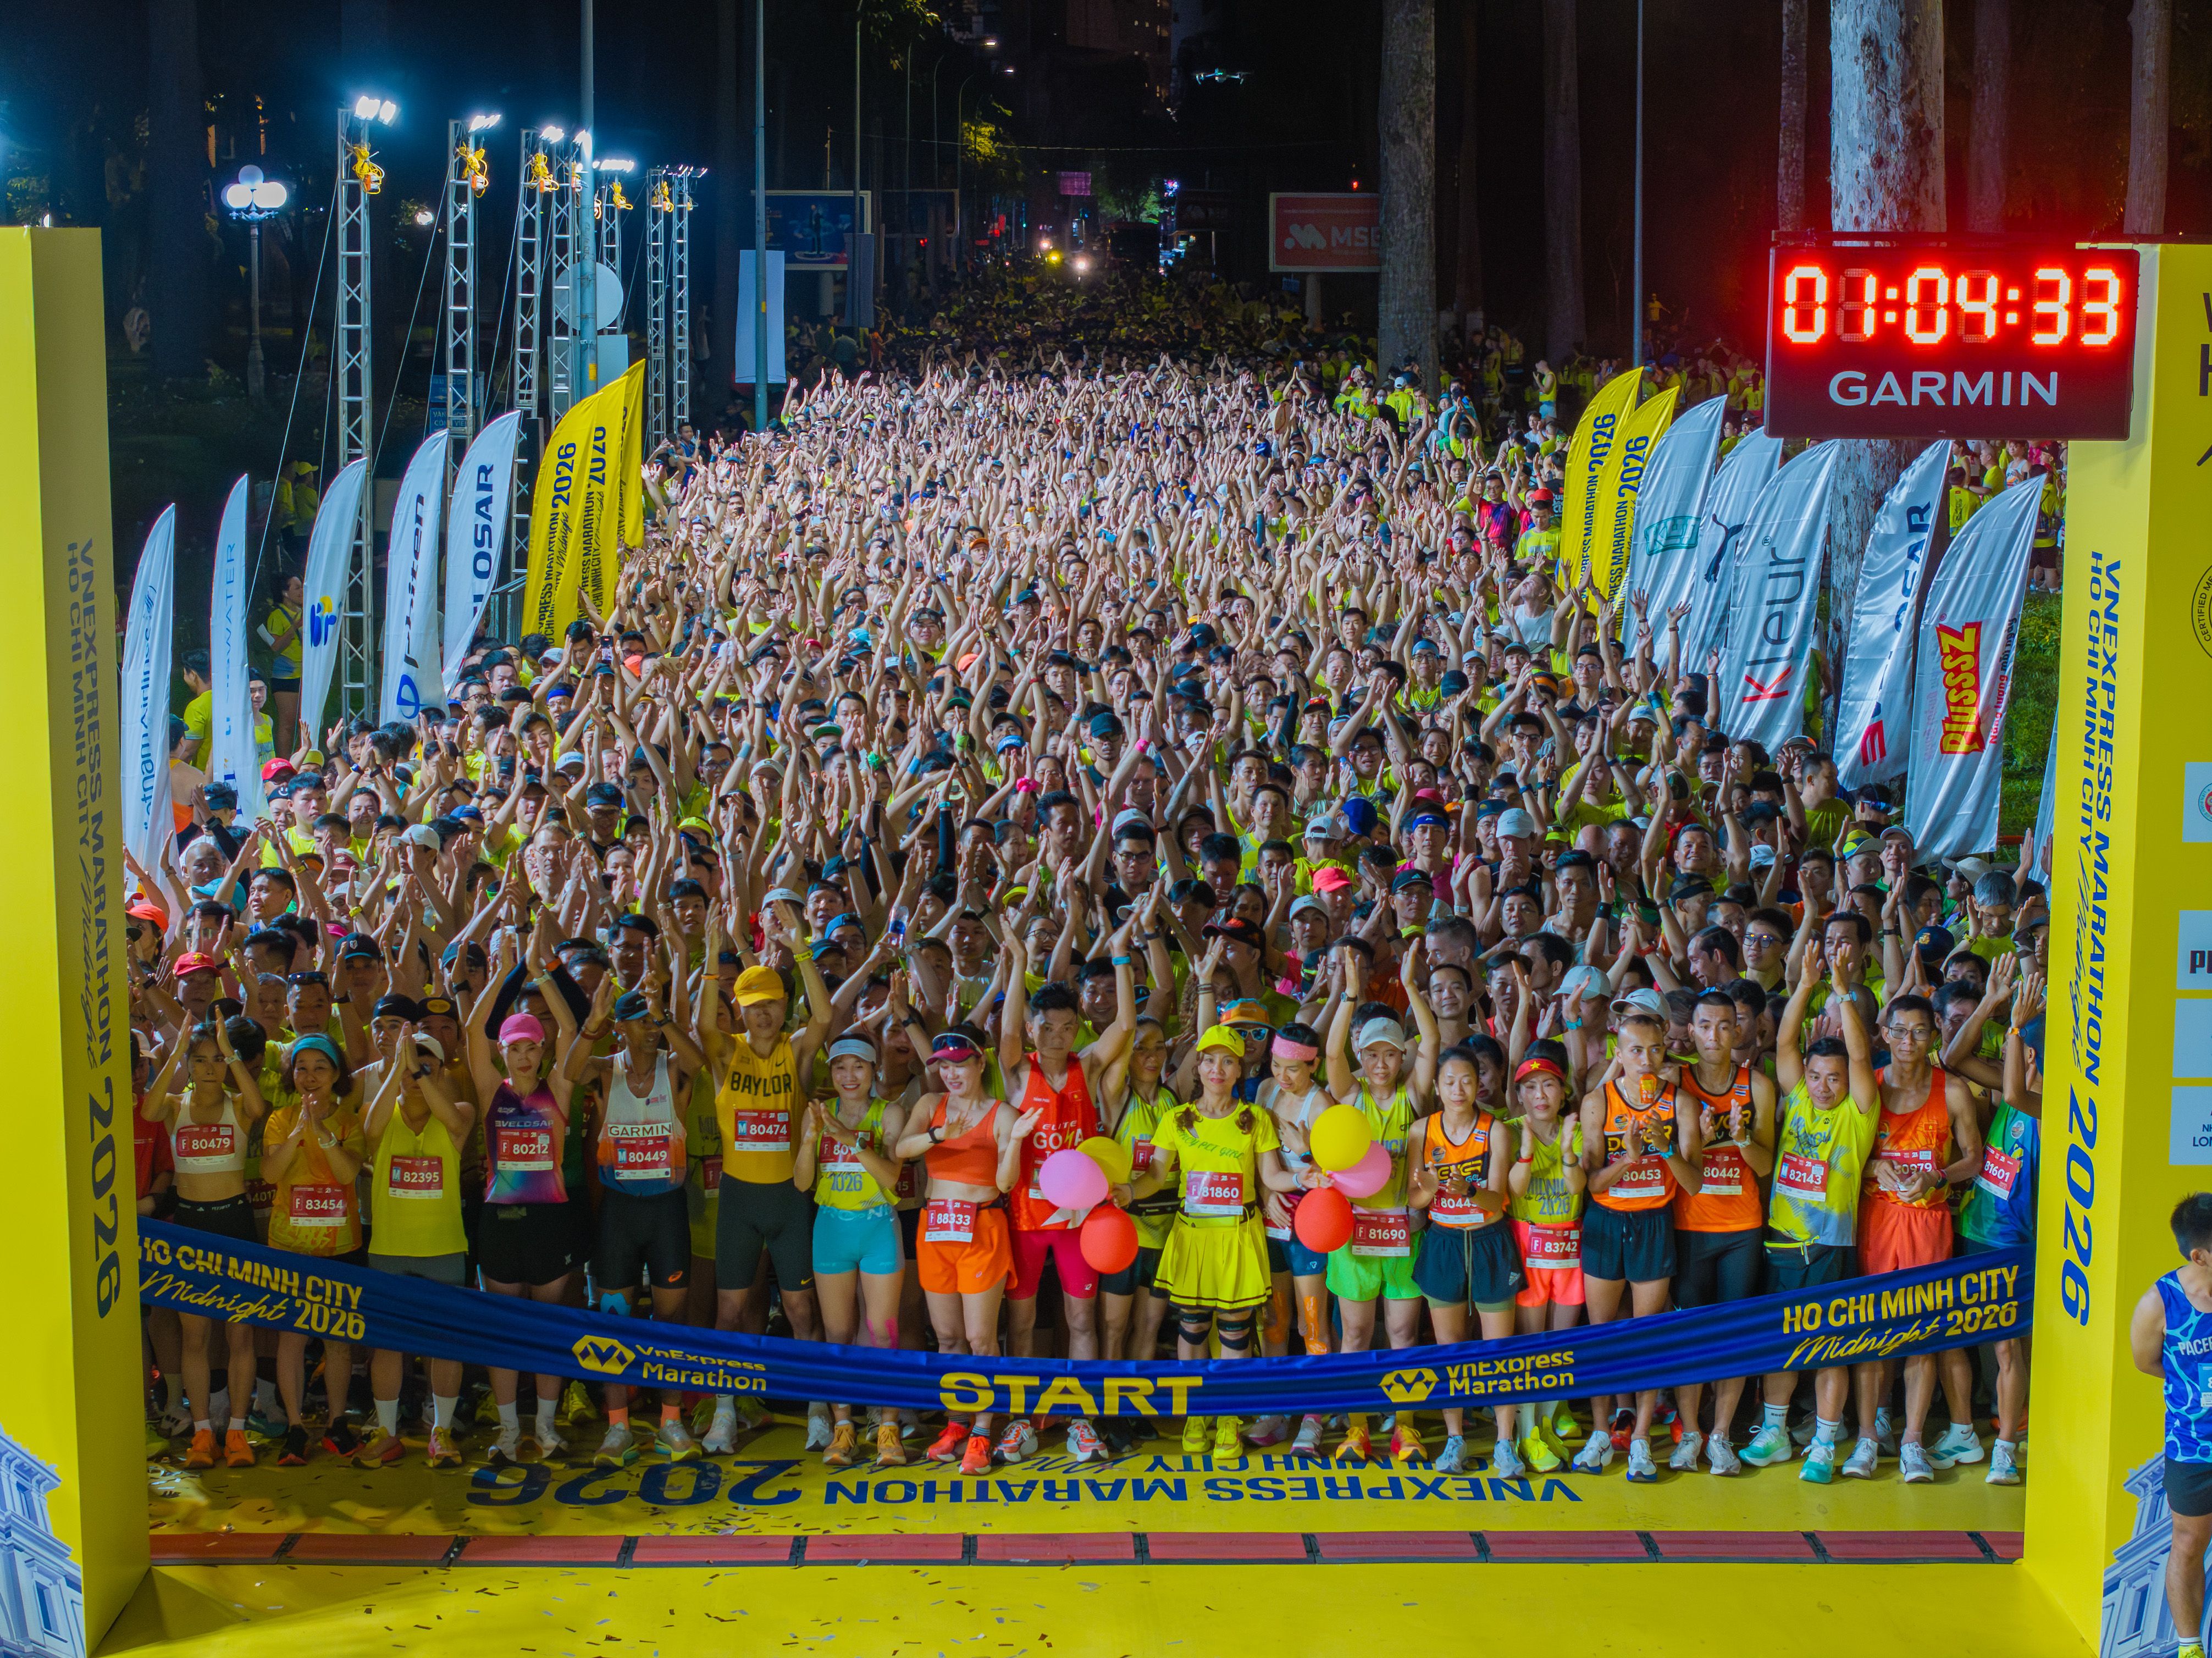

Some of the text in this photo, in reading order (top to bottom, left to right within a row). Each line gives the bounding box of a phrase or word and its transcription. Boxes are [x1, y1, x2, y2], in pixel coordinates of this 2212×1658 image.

[1784, 266, 2119, 345] 01:04:33
[1829, 371, 2058, 406] GARMIN
[1589, 413, 1616, 472] 2026
[551, 443, 576, 509] 2026
[1618, 436, 1649, 498] 2026
[1583, 474, 1599, 537] MARATHON
[1611, 500, 1628, 563] MARATHON
[68, 543, 79, 593] HO
[2090, 550, 2103, 601] HO
[70, 601, 82, 664] CHI
[1742, 547, 1806, 703] Kleur
[2197, 592, 2211, 642] CERTIFIED
[2087, 609, 2100, 670] CHI
[73, 670, 86, 767] MINH
[2083, 676, 2098, 771] MINH
[77, 773, 89, 847] CITY
[2079, 777, 2093, 855] CITY
[81, 537, 121, 1319] VNEXPRESS MARATHON 2026
[2061, 560, 2121, 1327] VNEXPRESS MARATHON 2026
[731, 1071, 792, 1097] BAYLOR
[192, 1137, 230, 1150] 80479
[609, 1124, 672, 1137] GARMIN
[750, 1124, 787, 1135] 80474
[1042, 1120, 1077, 1130] ELITE
[513, 1143, 549, 1154] 80212
[628, 1151, 667, 1163] 80449
[403, 1171, 439, 1182] 82395
[1202, 1186, 1239, 1198] 81860
[1623, 1169, 1661, 1181] 80453
[1703, 1167, 1740, 1178] 80442
[1789, 1169, 1822, 1185] 82143
[1984, 1160, 2010, 1182] 81601
[306, 1199, 344, 1210] 83454
[937, 1213, 970, 1225] 88333
[1369, 1228, 1406, 1240] 81690
[1544, 1241, 1577, 1253] 83742
[137, 1235, 363, 1310] HO CHI MINH CITY
[139, 1270, 366, 1340] Midnight 2026
[1783, 1264, 2020, 1334] HO CHI MINH CITY
[1783, 1301, 2019, 1369] Midnight 2026
[635, 1344, 766, 1371] VnExpress
[643, 1362, 767, 1391] Marathon
[939, 1372, 1203, 1416] START
[1449, 1372, 1575, 1396] Marathon
[465, 1458, 806, 1507] 2026
[825, 1478, 1187, 1505] MARATHON
[1204, 1475, 1584, 1502] VNEXPRESS
